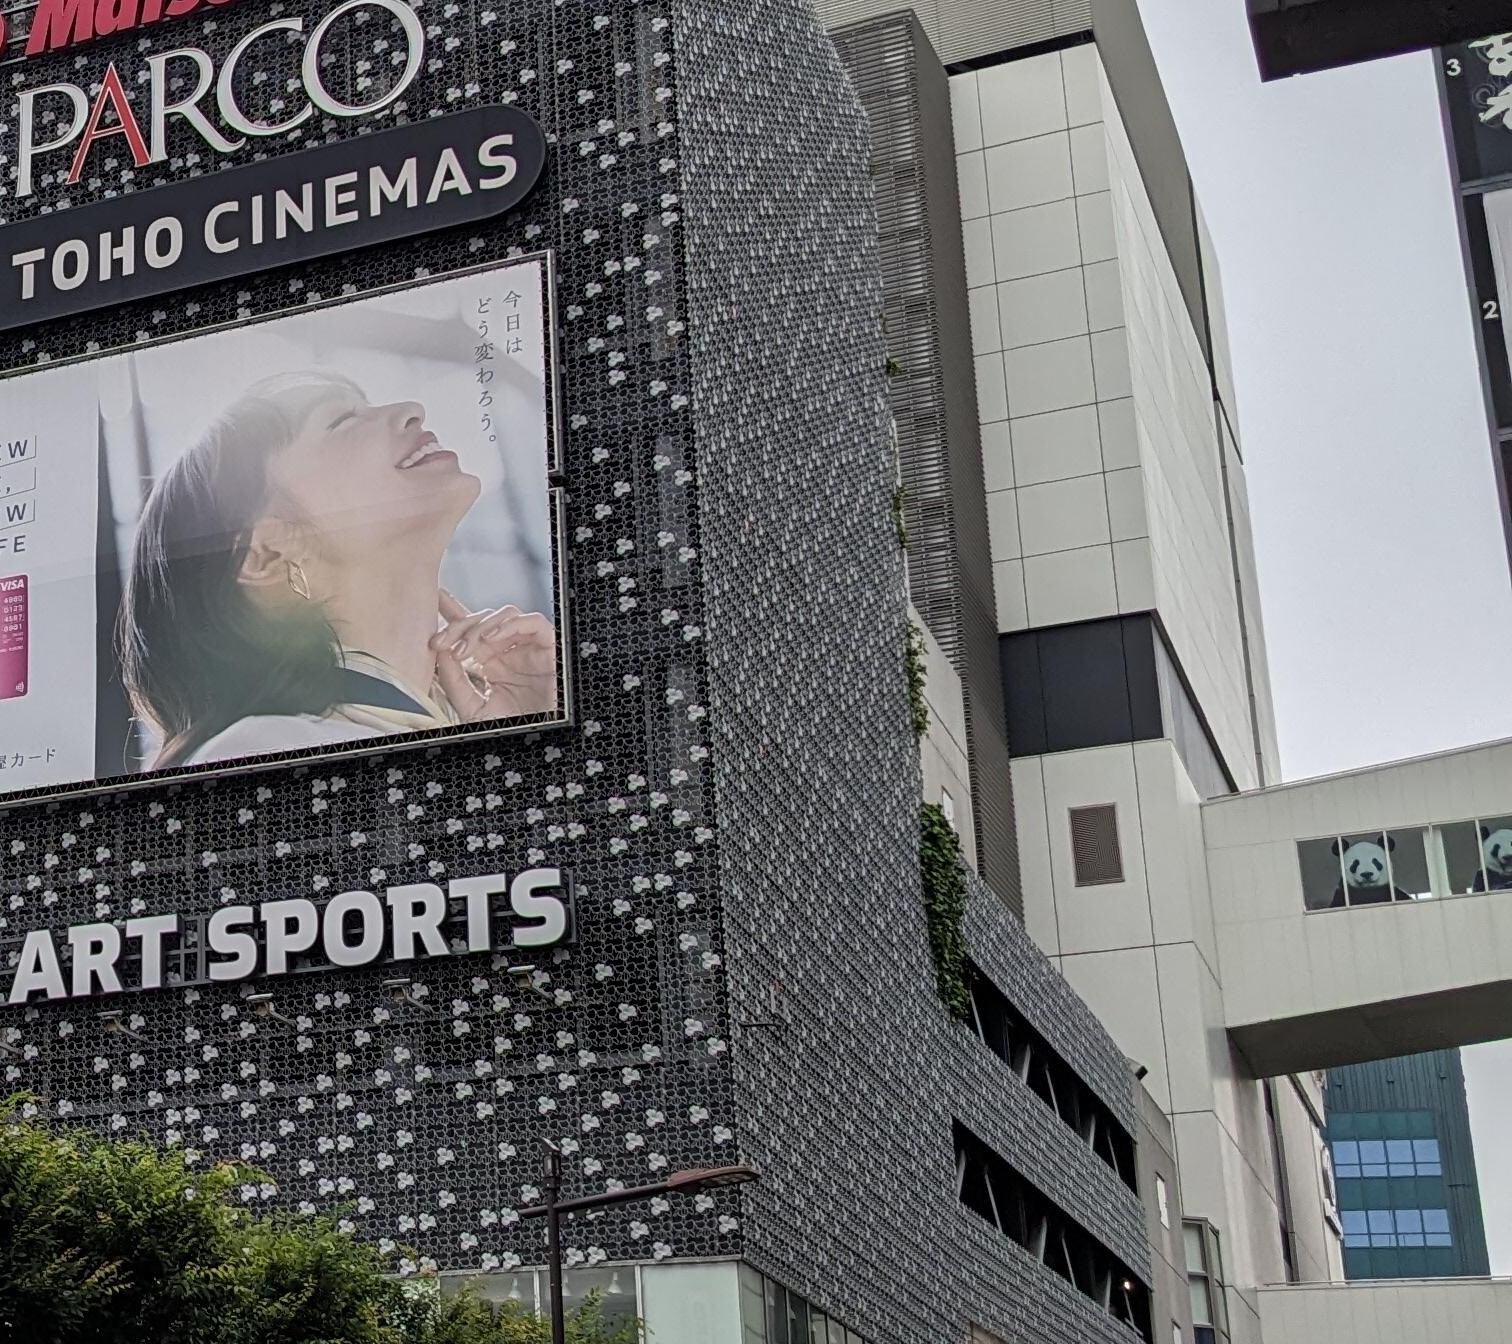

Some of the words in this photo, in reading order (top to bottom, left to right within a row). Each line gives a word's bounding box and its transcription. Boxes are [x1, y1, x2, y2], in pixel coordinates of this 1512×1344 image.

[1446, 58, 1461, 76] 3
[12, 216, 184, 300] TOHO
[204, 134, 518, 253] CINEMAS
[502, 290, 523, 354] 今日は
[1482, 300, 1499, 320] 2
[475, 297, 497, 442] どう変わろう。
[0, 579, 25, 592] VISA
[8, 915, 178, 1004] ART
[206, 867, 568, 982] SPORTS
